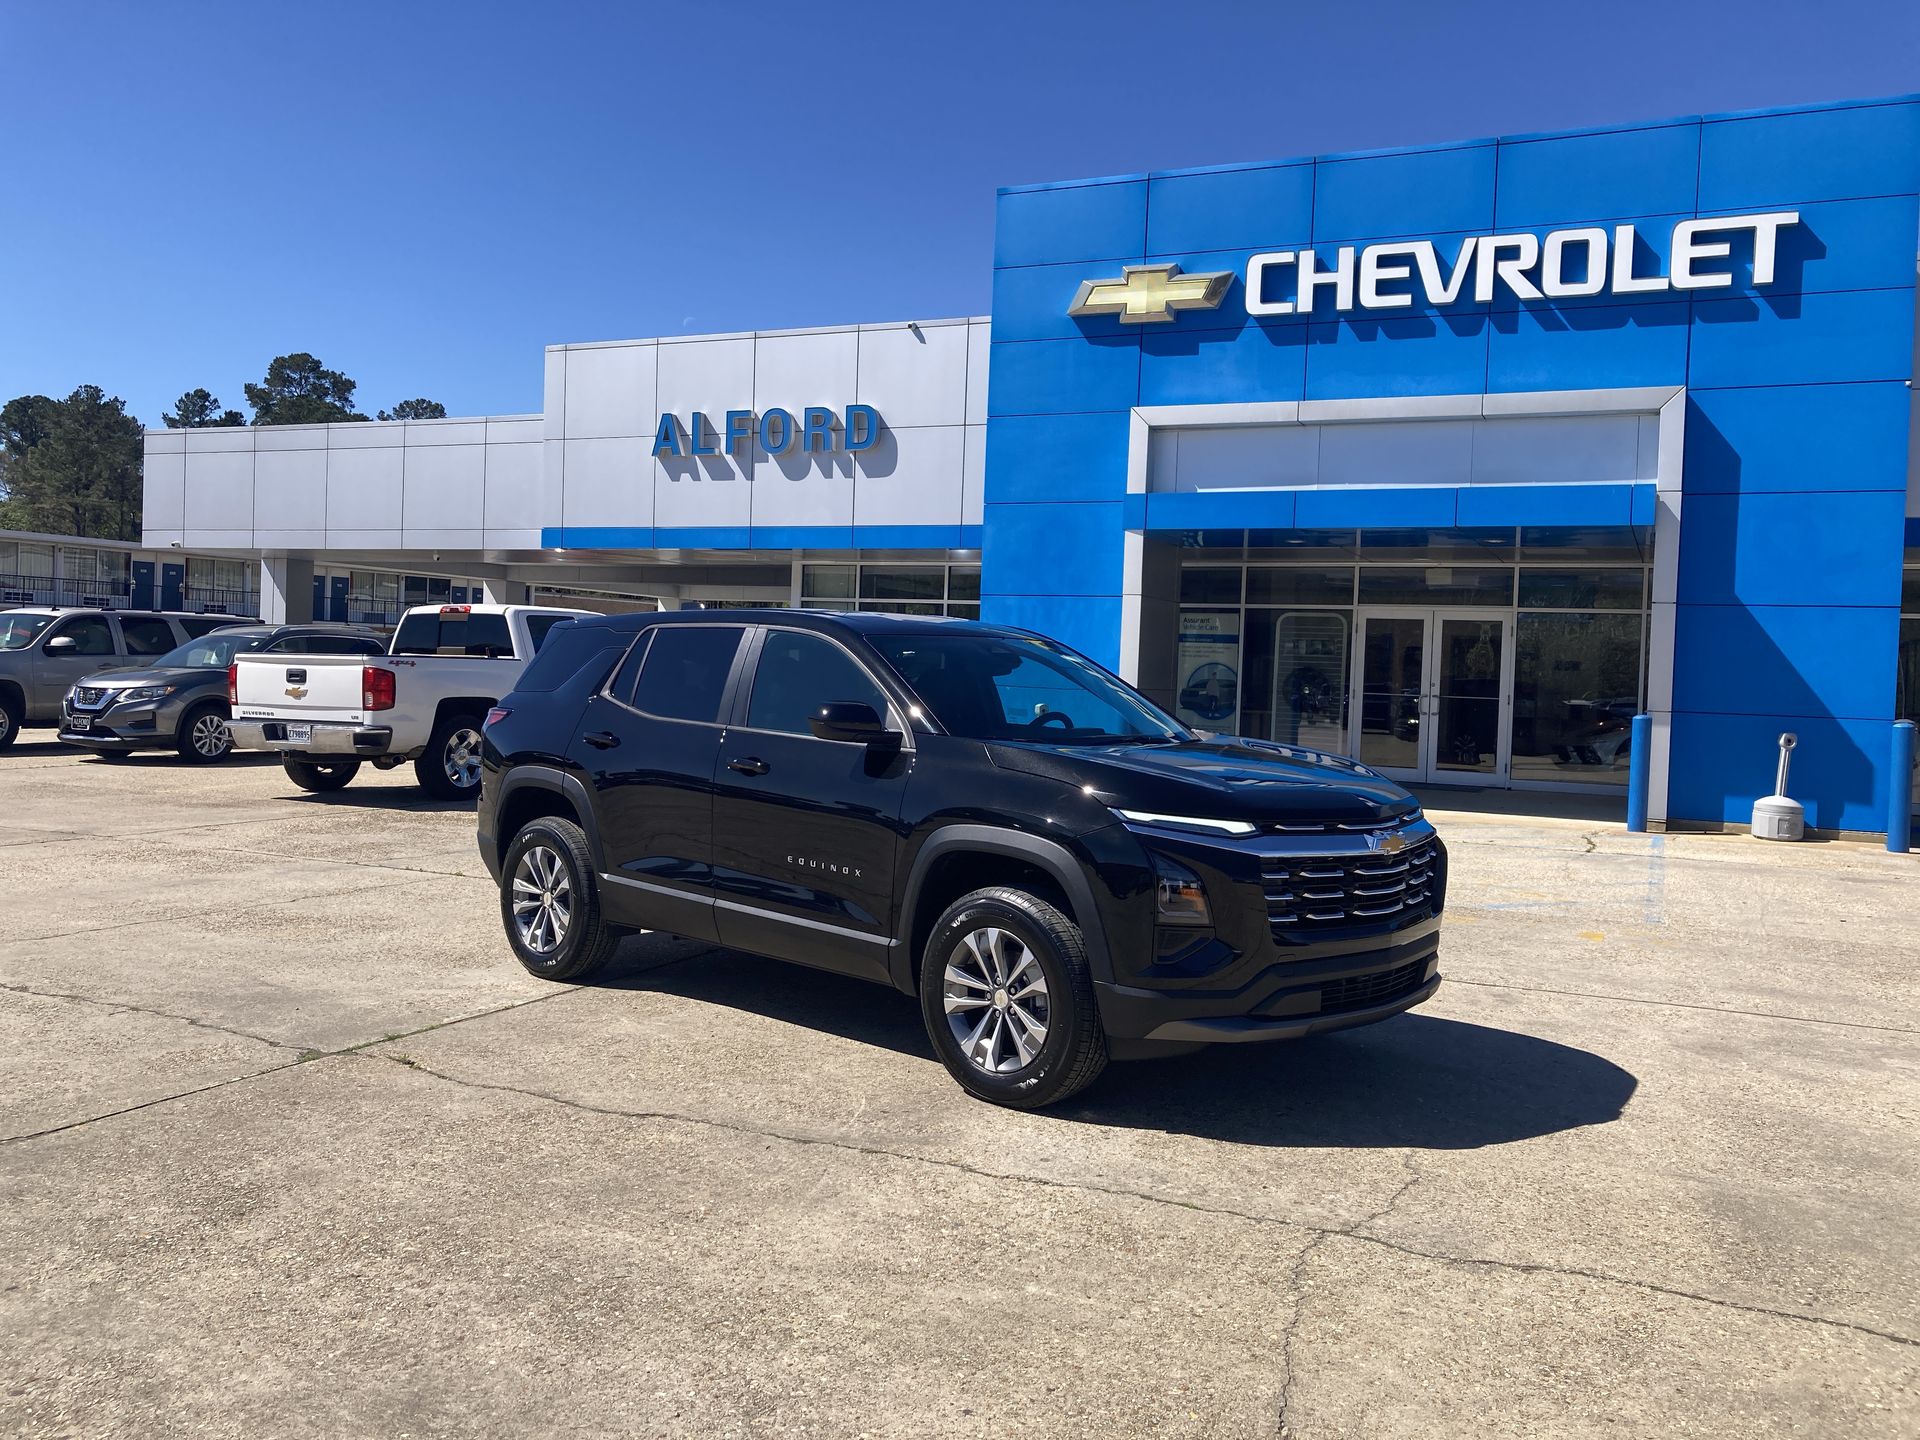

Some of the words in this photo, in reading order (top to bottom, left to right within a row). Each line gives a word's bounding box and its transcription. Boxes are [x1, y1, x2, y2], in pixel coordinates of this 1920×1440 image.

[1245, 211, 1799, 315] CHEVROLET
[651, 404, 881, 457] ALFORD
[787, 855, 861, 877] EQUINOX
